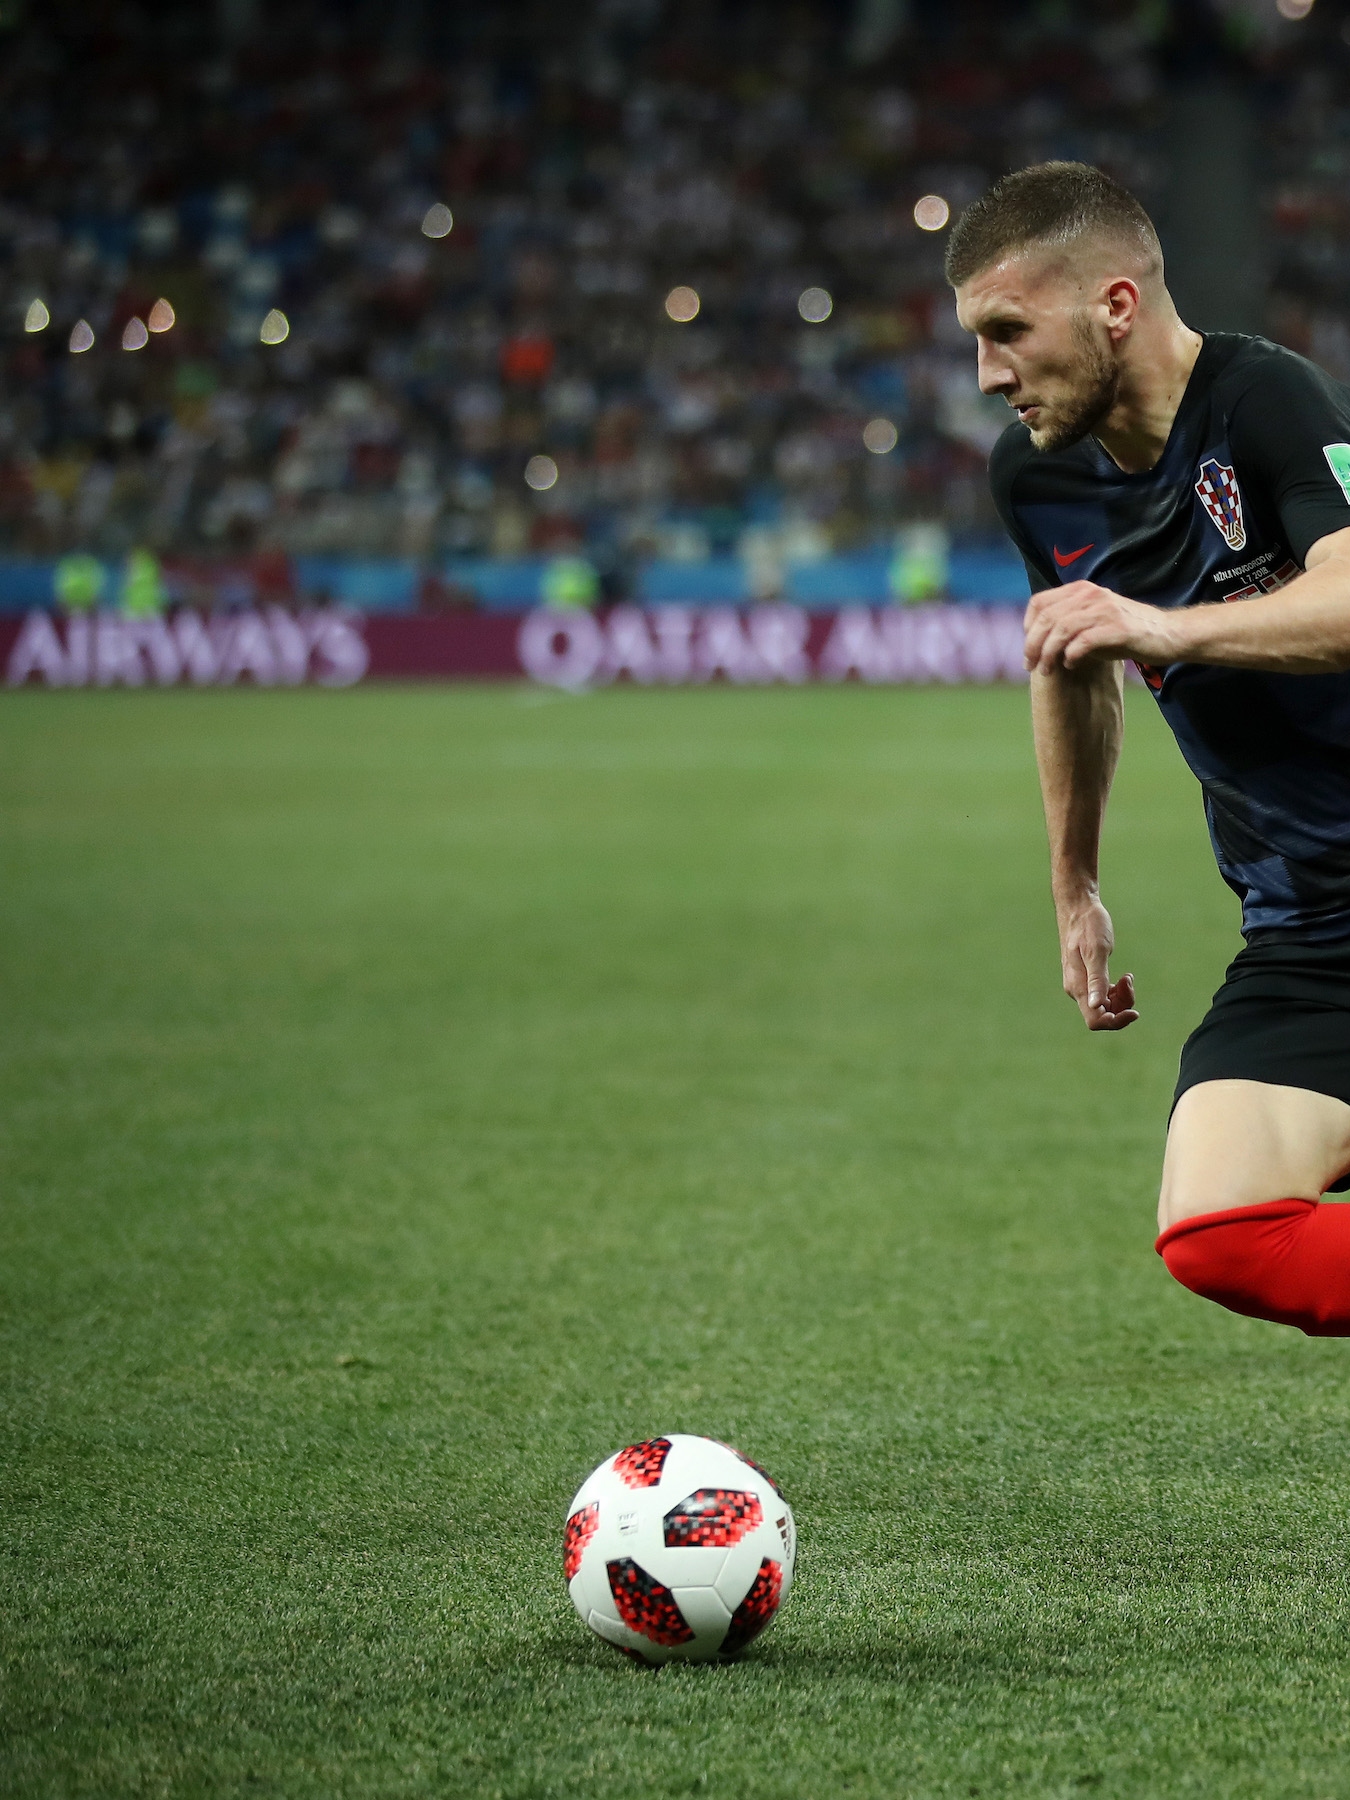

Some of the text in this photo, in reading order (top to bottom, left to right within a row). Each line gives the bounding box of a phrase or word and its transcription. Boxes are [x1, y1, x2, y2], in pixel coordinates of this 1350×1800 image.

[1232, 555, 1267, 576] NOVGOROD
[5, 604, 371, 688] AIRWAYS
[516, 604, 1026, 693] QATAR AIRW
